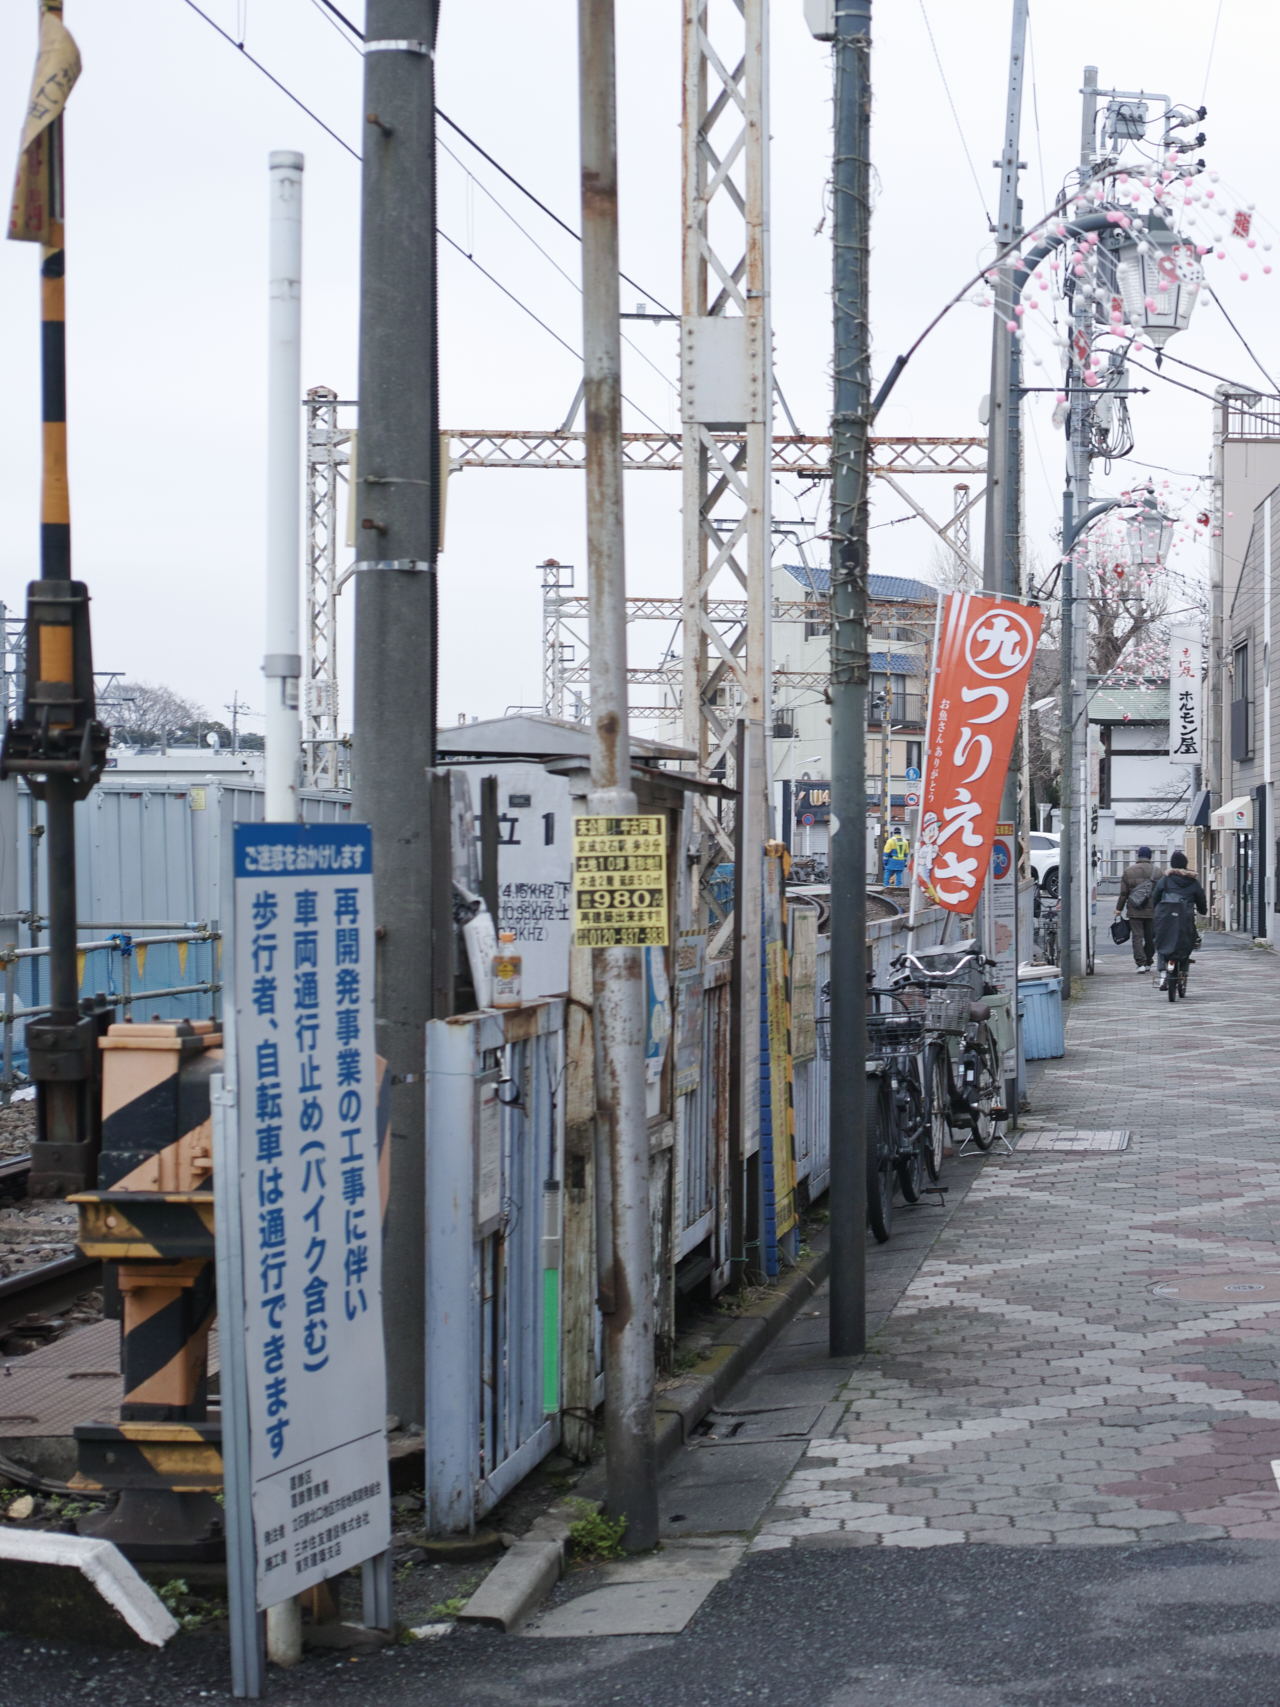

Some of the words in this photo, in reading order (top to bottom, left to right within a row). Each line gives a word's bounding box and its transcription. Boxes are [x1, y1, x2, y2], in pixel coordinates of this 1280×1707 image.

[935, 698, 950, 743] お魚さん
[1173, 691, 1198, 754] ホルモン屋
[928, 746, 943, 803] ありがとう
[934, 685, 1010, 905] つりえさ
[244, 843, 364, 872] ご迷惑をおかけします
[593, 890, 652, 909] 980
[333, 887, 369, 1322] 再開発事業の工事に伴い
[251, 890, 290, 1460] 歩行者、自転車は通行できます
[264, 1550, 288, 1573] 施工者
[294, 1511, 371, 1558] 三井住友建設株式会社
